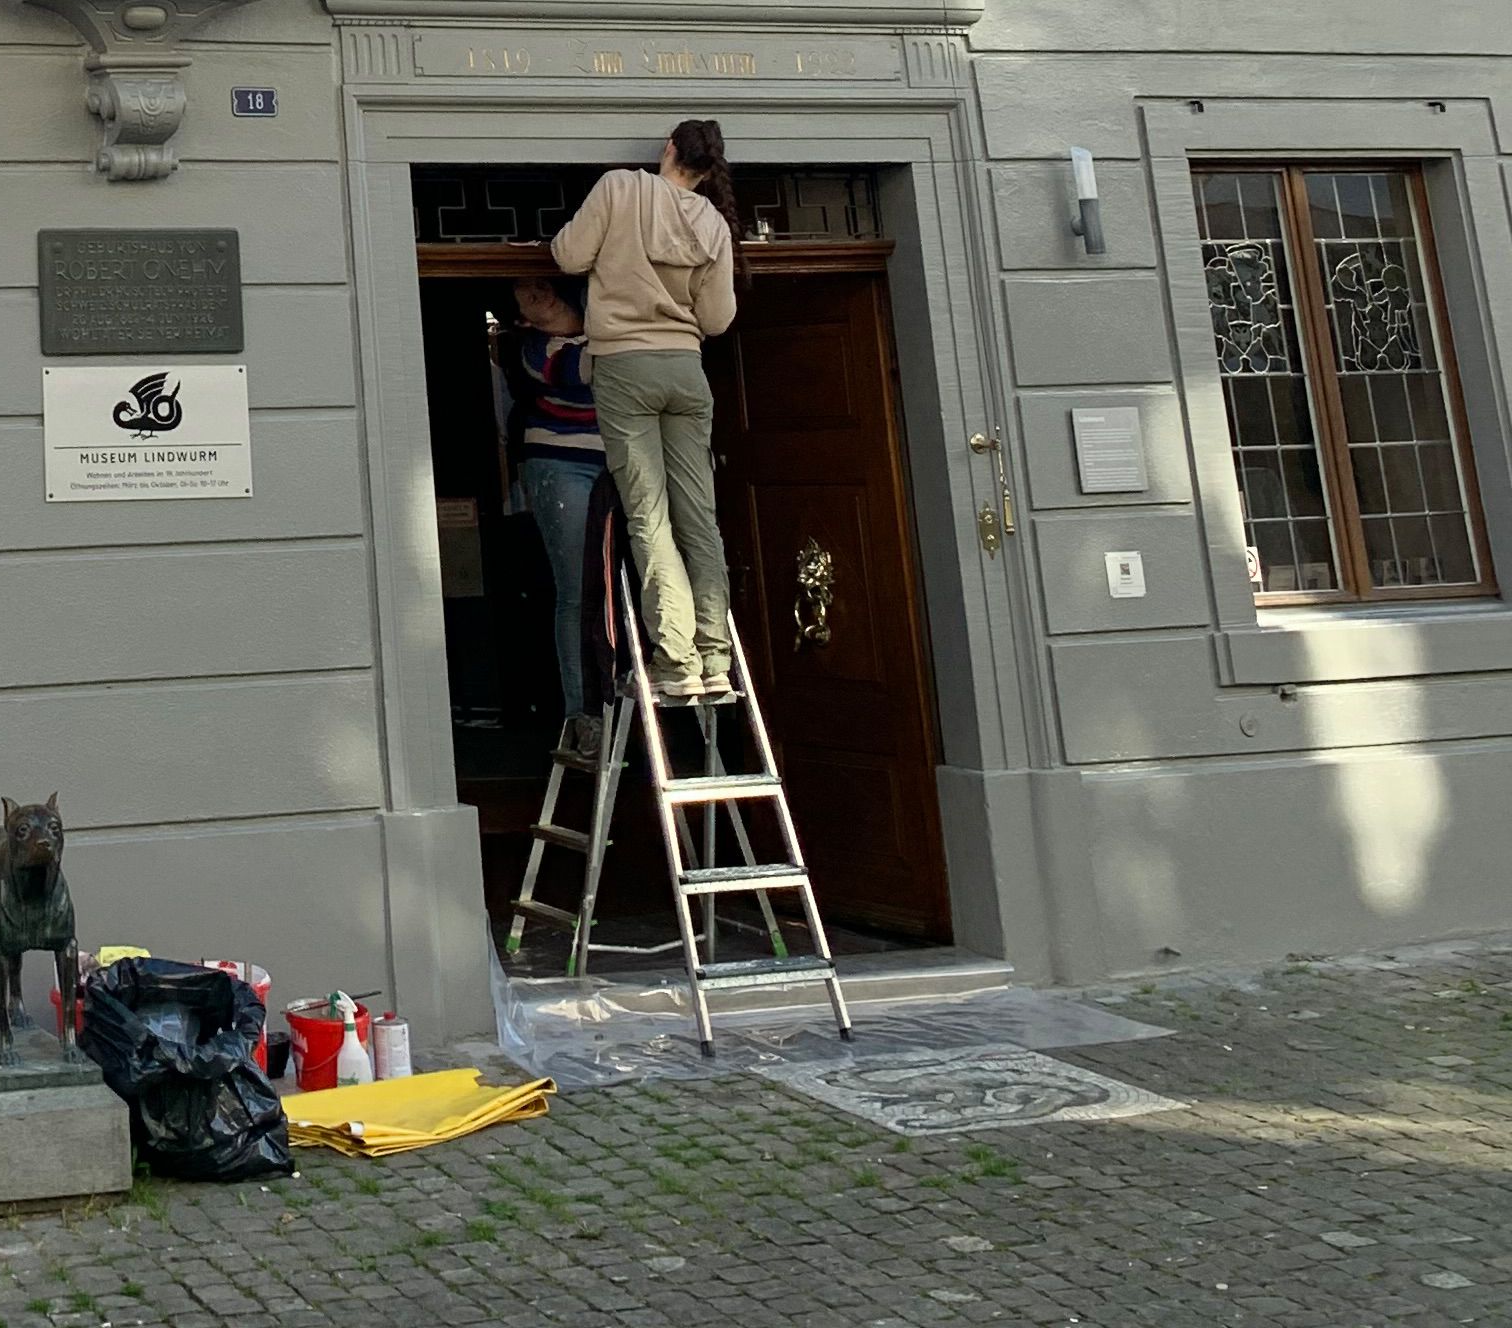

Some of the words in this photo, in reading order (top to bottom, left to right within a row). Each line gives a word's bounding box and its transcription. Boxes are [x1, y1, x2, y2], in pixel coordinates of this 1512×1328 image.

[247, 92, 264, 110] 18
[55, 259, 138, 281] ROBERT
[80, 452, 138, 464] MUSEUM
[144, 451, 218, 463] LINDWURM
[114, 471, 126, 479] und
